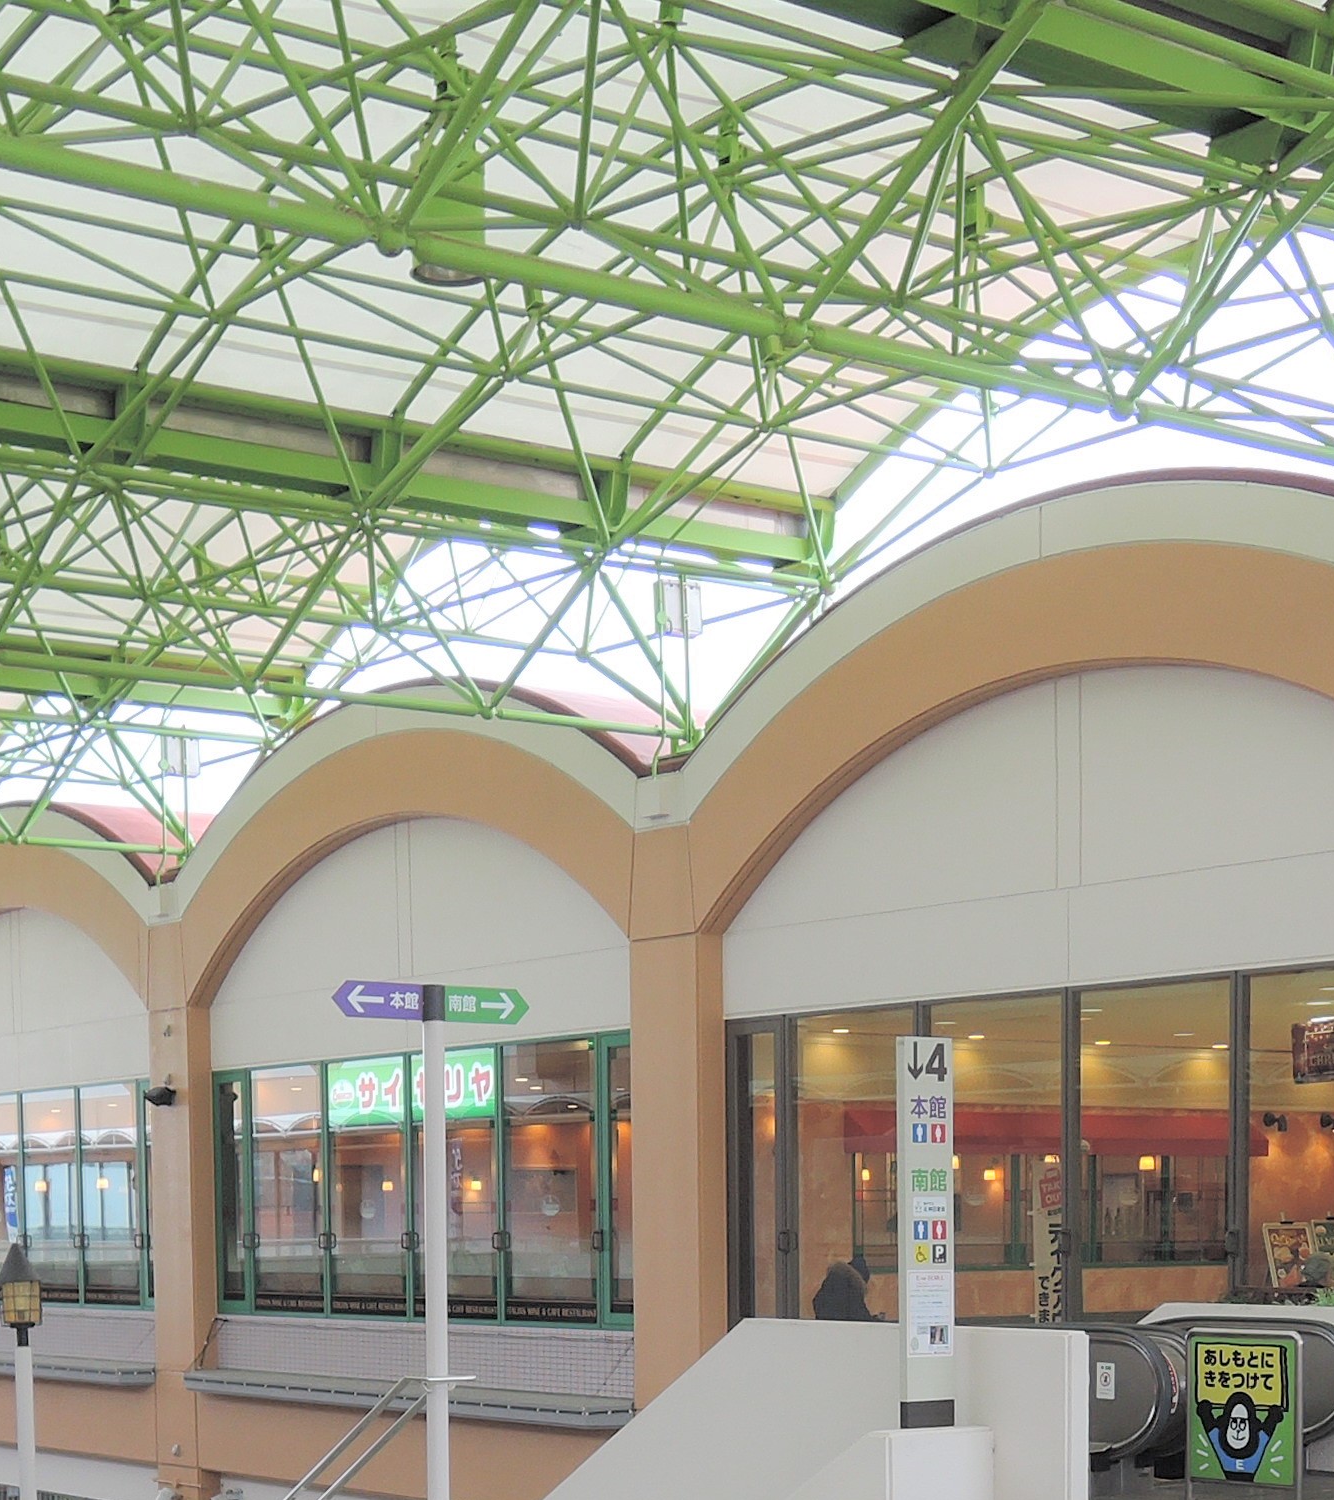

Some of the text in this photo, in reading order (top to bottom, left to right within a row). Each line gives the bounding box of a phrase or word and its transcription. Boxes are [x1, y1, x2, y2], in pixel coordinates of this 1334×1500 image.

[389, 992, 420, 1010] 本館
[448, 995, 477, 1013] 南館
[925, 1043, 947, 1082] 4
[910, 1095, 947, 1119] 本館
[911, 1168, 947, 1192] 南館
[935, 1245, 944, 1258] P
[1203, 1349, 1275, 1369] あしもとに
[1203, 1371, 1274, 1391] きをつけて
[1235, 1459, 1244, 1471] E
